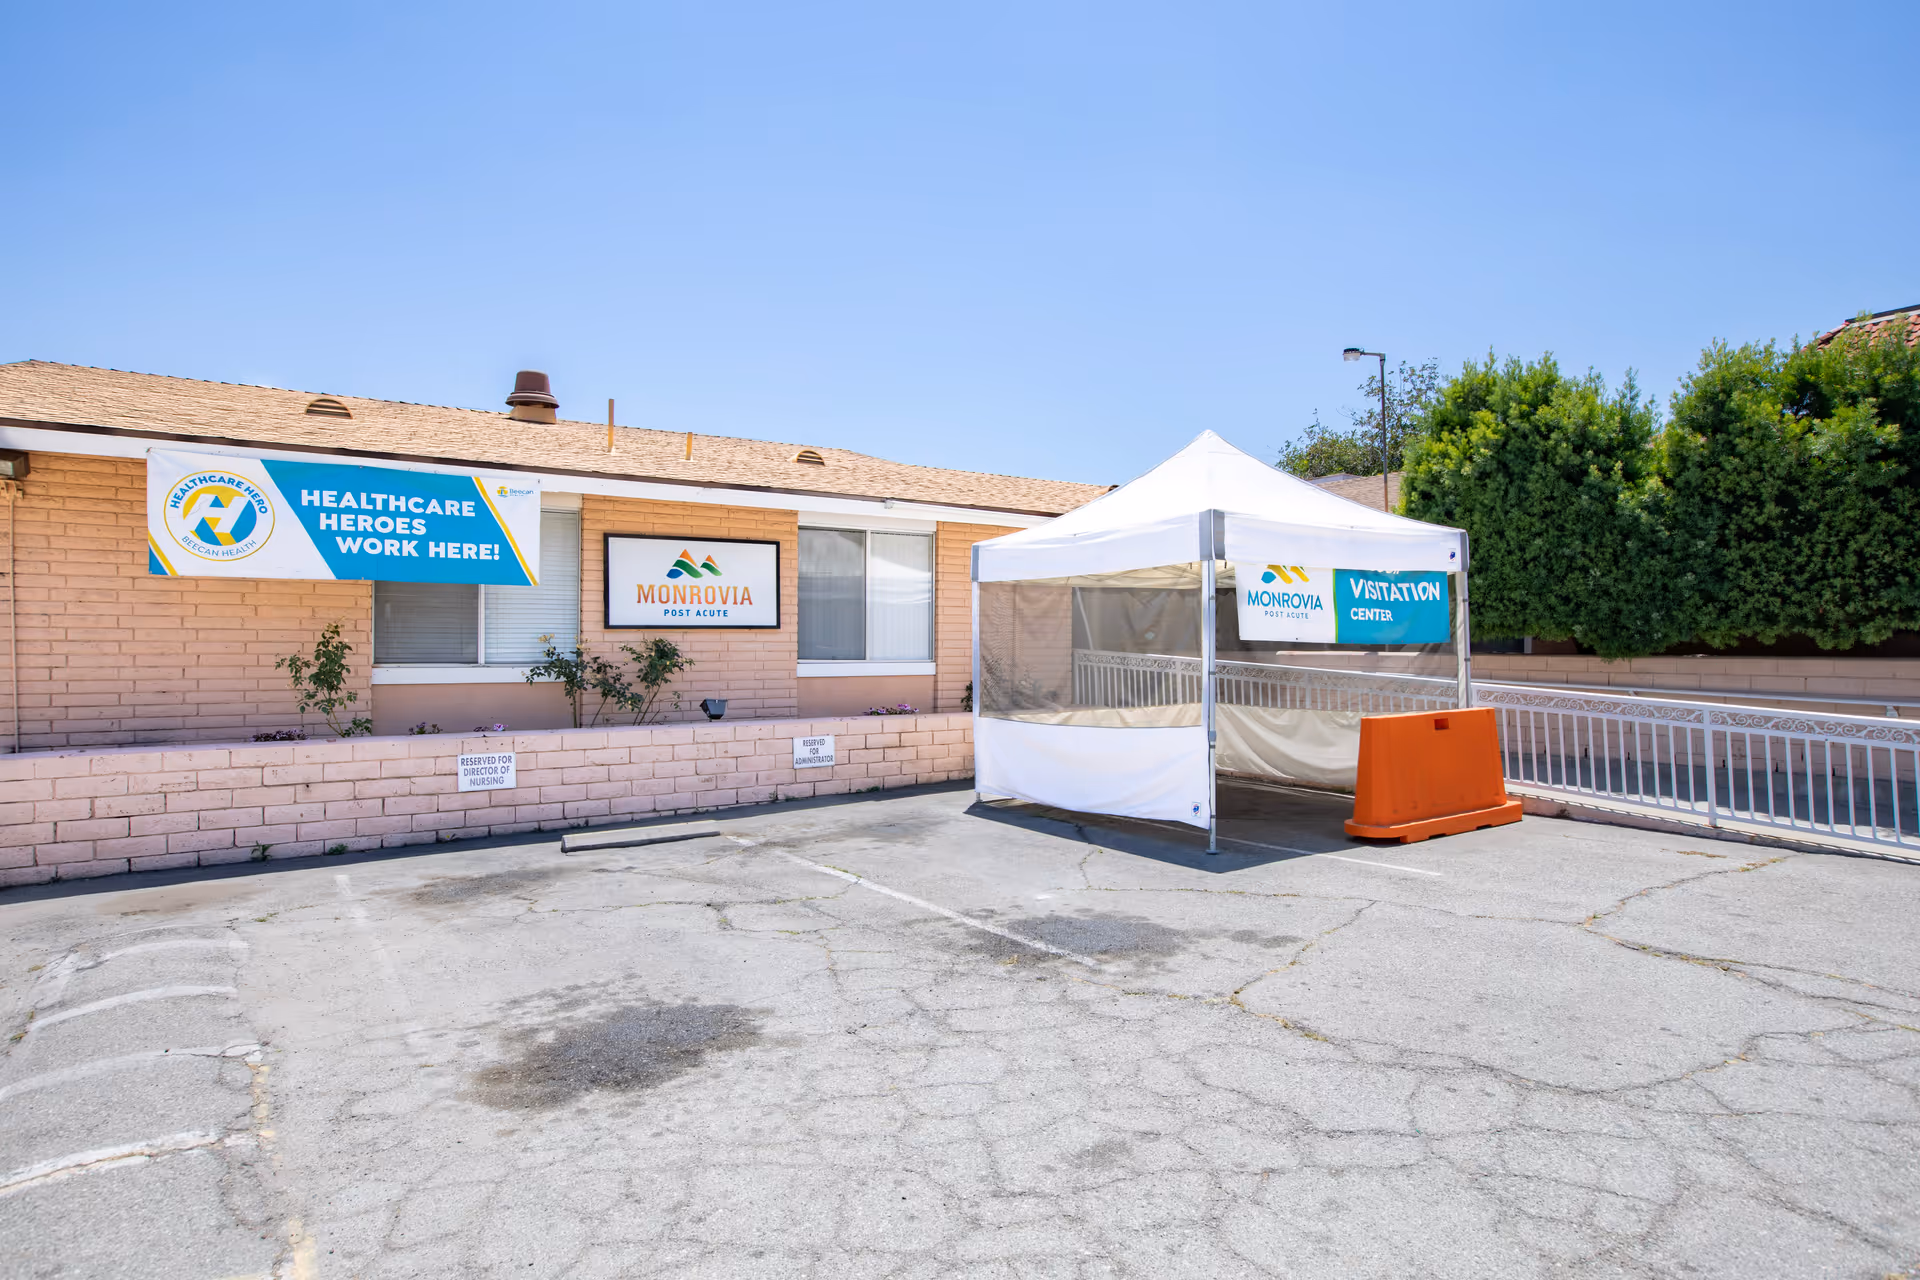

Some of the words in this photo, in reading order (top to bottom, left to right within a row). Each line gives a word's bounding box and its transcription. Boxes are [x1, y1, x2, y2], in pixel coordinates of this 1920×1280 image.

[170, 475, 245, 509] HEALTHCARE
[243, 486, 268, 514] HERO
[301, 489, 476, 517] HEALTHCARE
[319, 513, 427, 535] HEROES
[181, 535, 220, 557] BEECAN
[221, 539, 257, 557] HEALTH
[335, 536, 419, 557] WORK
[428, 541, 500, 561] HERE!
[636, 583, 753, 606] MONROVIA
[1349, 577, 1441, 602] VISITATION
[1247, 589, 1324, 611] MONROVIA
[663, 608, 691, 617] POST
[695, 609, 729, 617] ACUTE
[1264, 610, 1284, 618] POST
[1286, 611, 1309, 620] ACUTE
[1350, 607, 1394, 622] CENTER
[802, 738, 826, 746] RESERVED
[460, 756, 496, 766] RESERVED
[498, 756, 512, 764] FOR
[795, 755, 834, 764] ADMINISTRATOR
[464, 766, 498, 776] DIRECTOR
[500, 766, 510, 774] OF
[470, 776, 504, 786] NURSING
